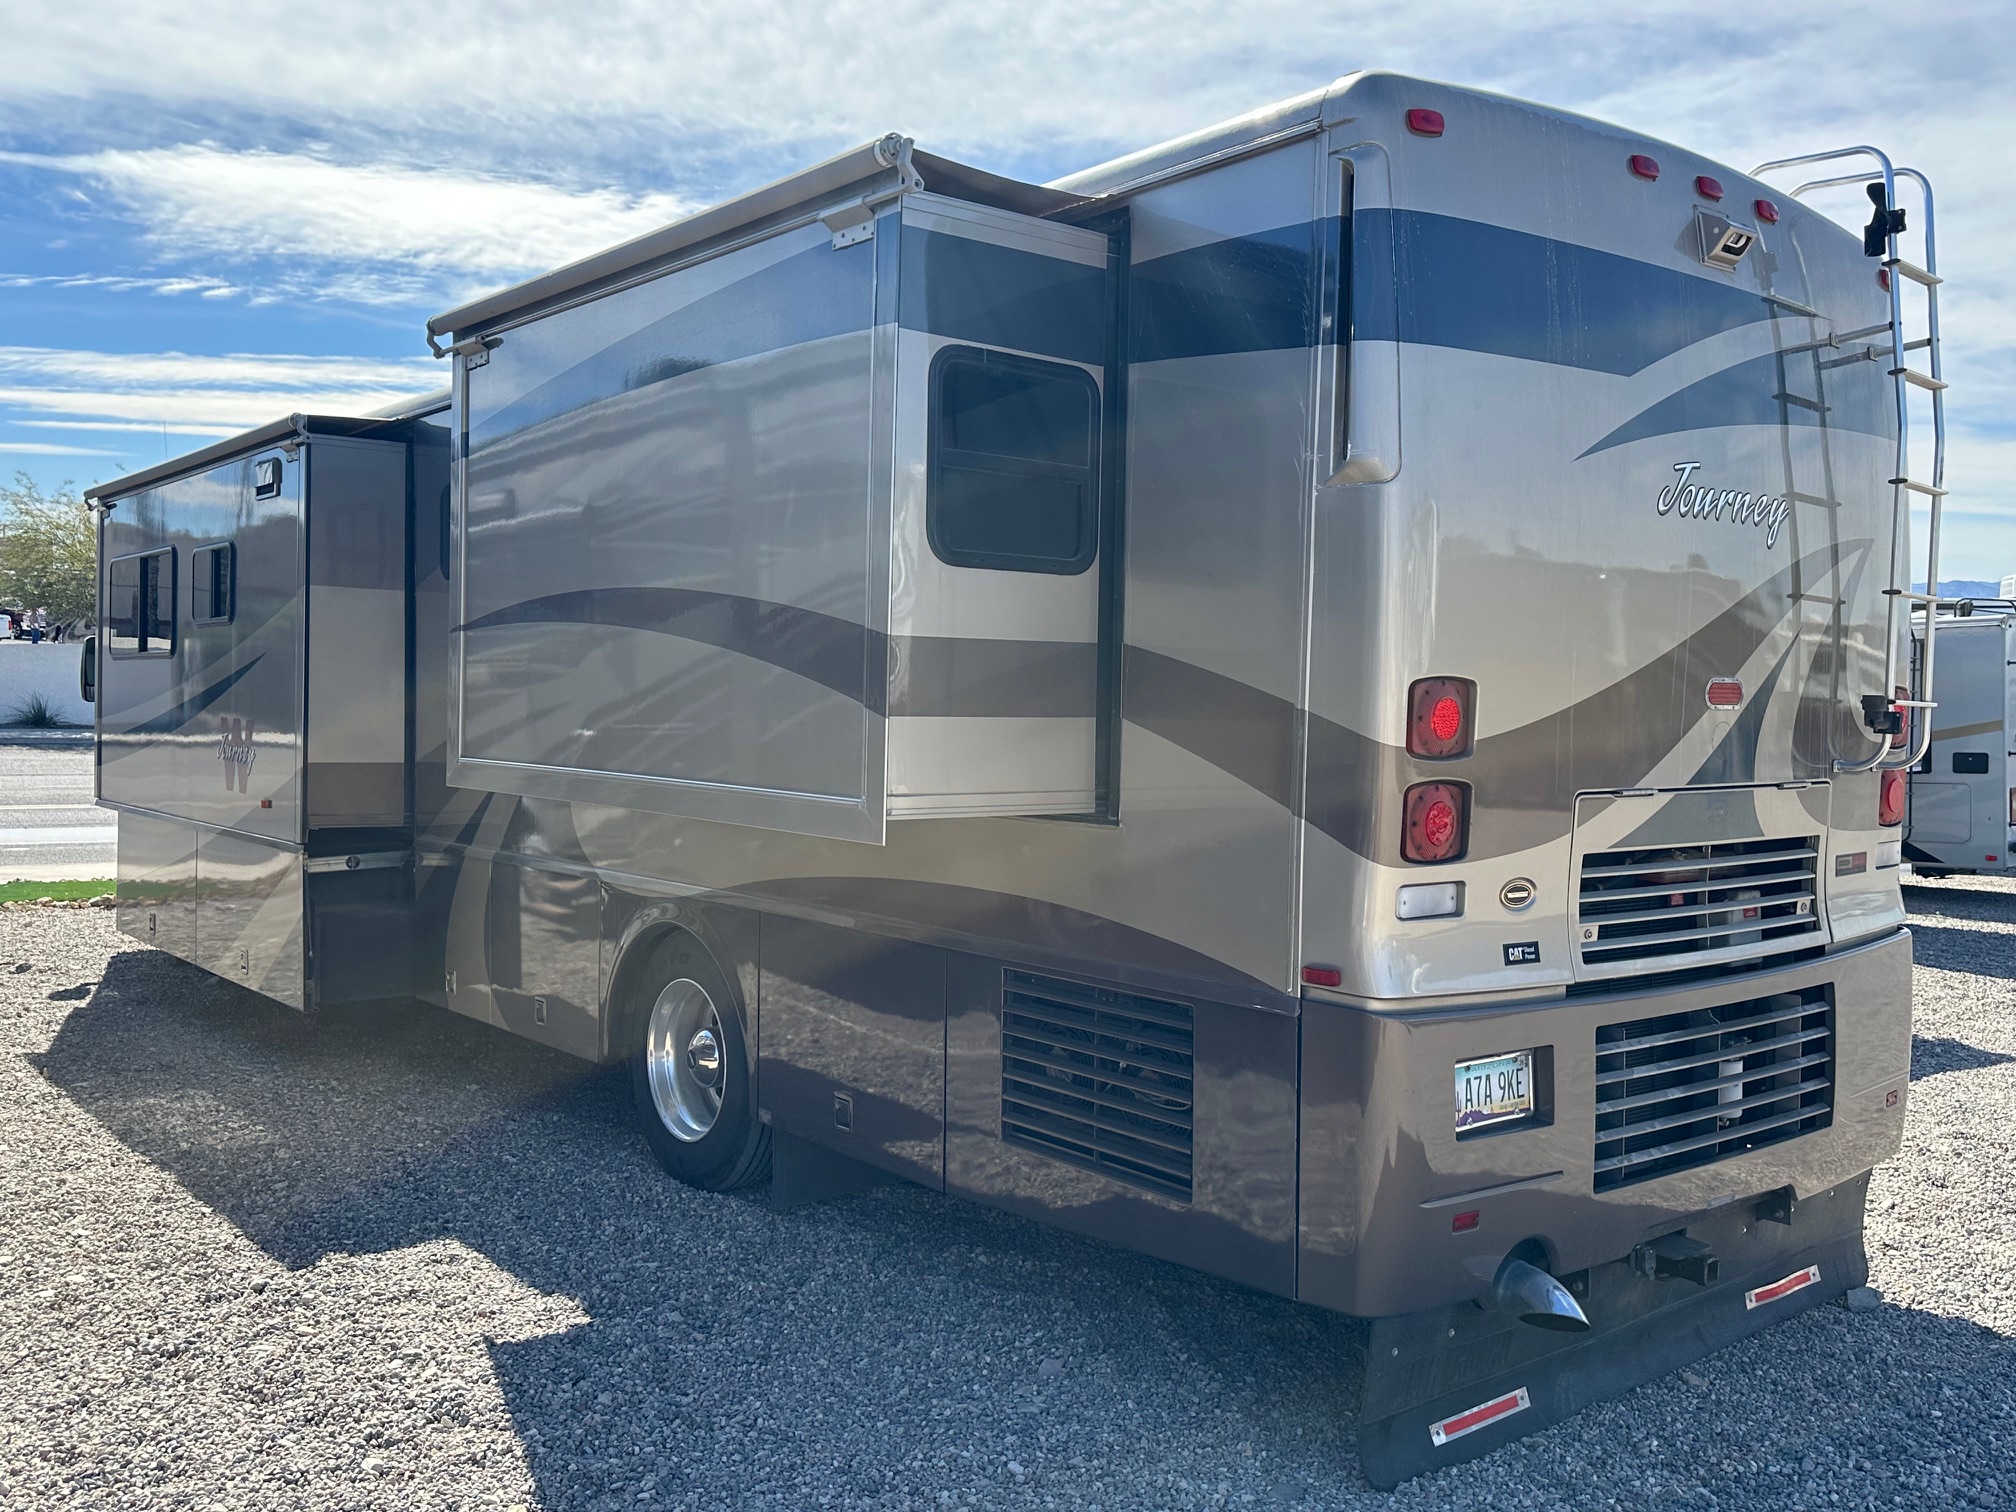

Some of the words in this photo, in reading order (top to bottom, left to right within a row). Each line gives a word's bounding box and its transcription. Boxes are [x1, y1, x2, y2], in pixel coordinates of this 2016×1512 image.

[1657, 461, 1790, 550] Journey
[217, 732, 256, 777] Journey
[1508, 947, 1523, 961] CAT
[1471, 1060, 1512, 1073] ARIZONA
[1465, 1073, 1493, 1110] A7A
[1497, 1068, 1525, 1103] 9KE
